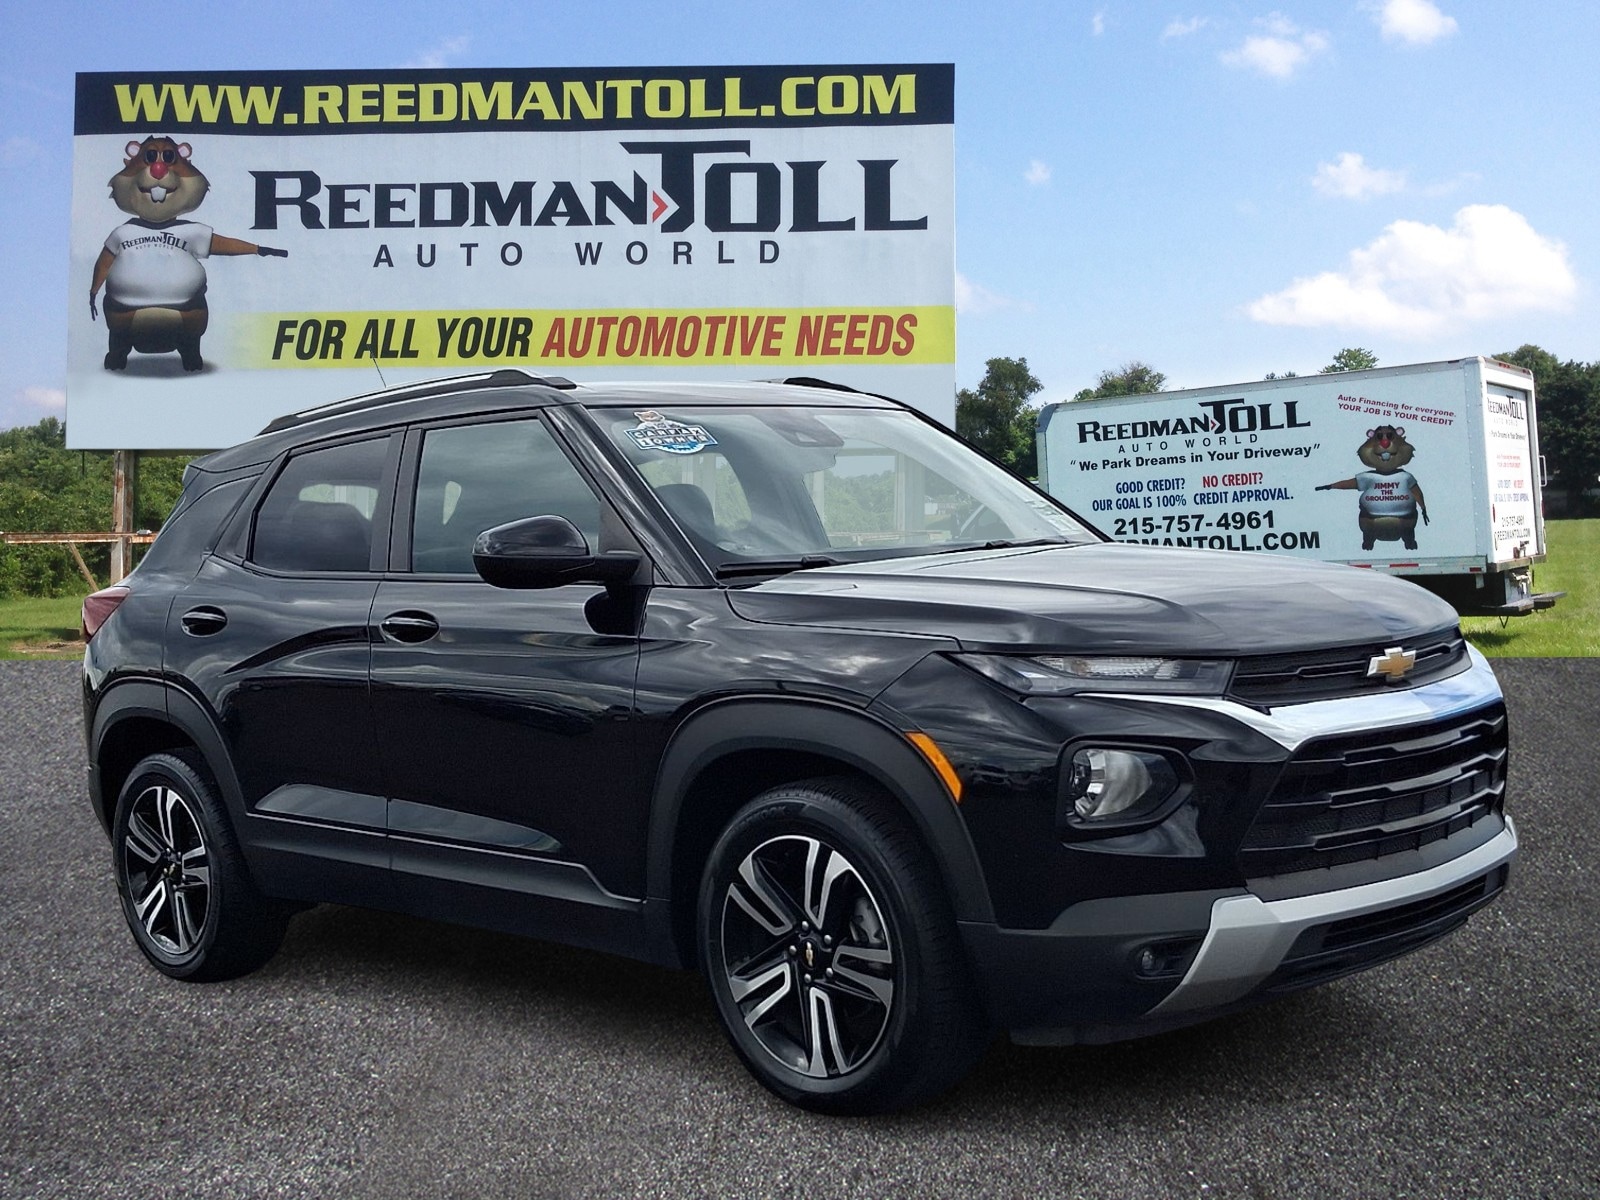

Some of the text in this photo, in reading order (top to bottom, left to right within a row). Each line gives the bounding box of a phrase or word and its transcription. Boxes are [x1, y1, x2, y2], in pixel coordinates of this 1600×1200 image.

[114, 74, 916, 125] WWW.REEDMANTOLL.COM
[373, 240, 780, 268] AUTO WORLD
[272, 313, 919, 360] FOR ALL YOUR AUTOMOTIVE NEEDS
[1338, 394, 1457, 418] Auto Financing for everyone.
[1338, 403, 1454, 426] YOUR JOB IS YOUR CREDIT
[634, 427, 706, 438] CARFAX
[1118, 434, 1258, 454] AUTO WORLD
[1102, 458, 1131, 469] Park
[1136, 455, 1186, 467] Dreams
[1191, 452, 1203, 463] in
[1207, 451, 1239, 461] Your
[1116, 472, 1263, 494] GOOD CREDIT? NO CREDIT?
[1092, 487, 1294, 511] OUR GOAL IS 100% CREDIT APPROVAL.
[1114, 510, 1274, 536] 215-757-4961
[1116, 531, 1321, 551] ANTOLL.COM
